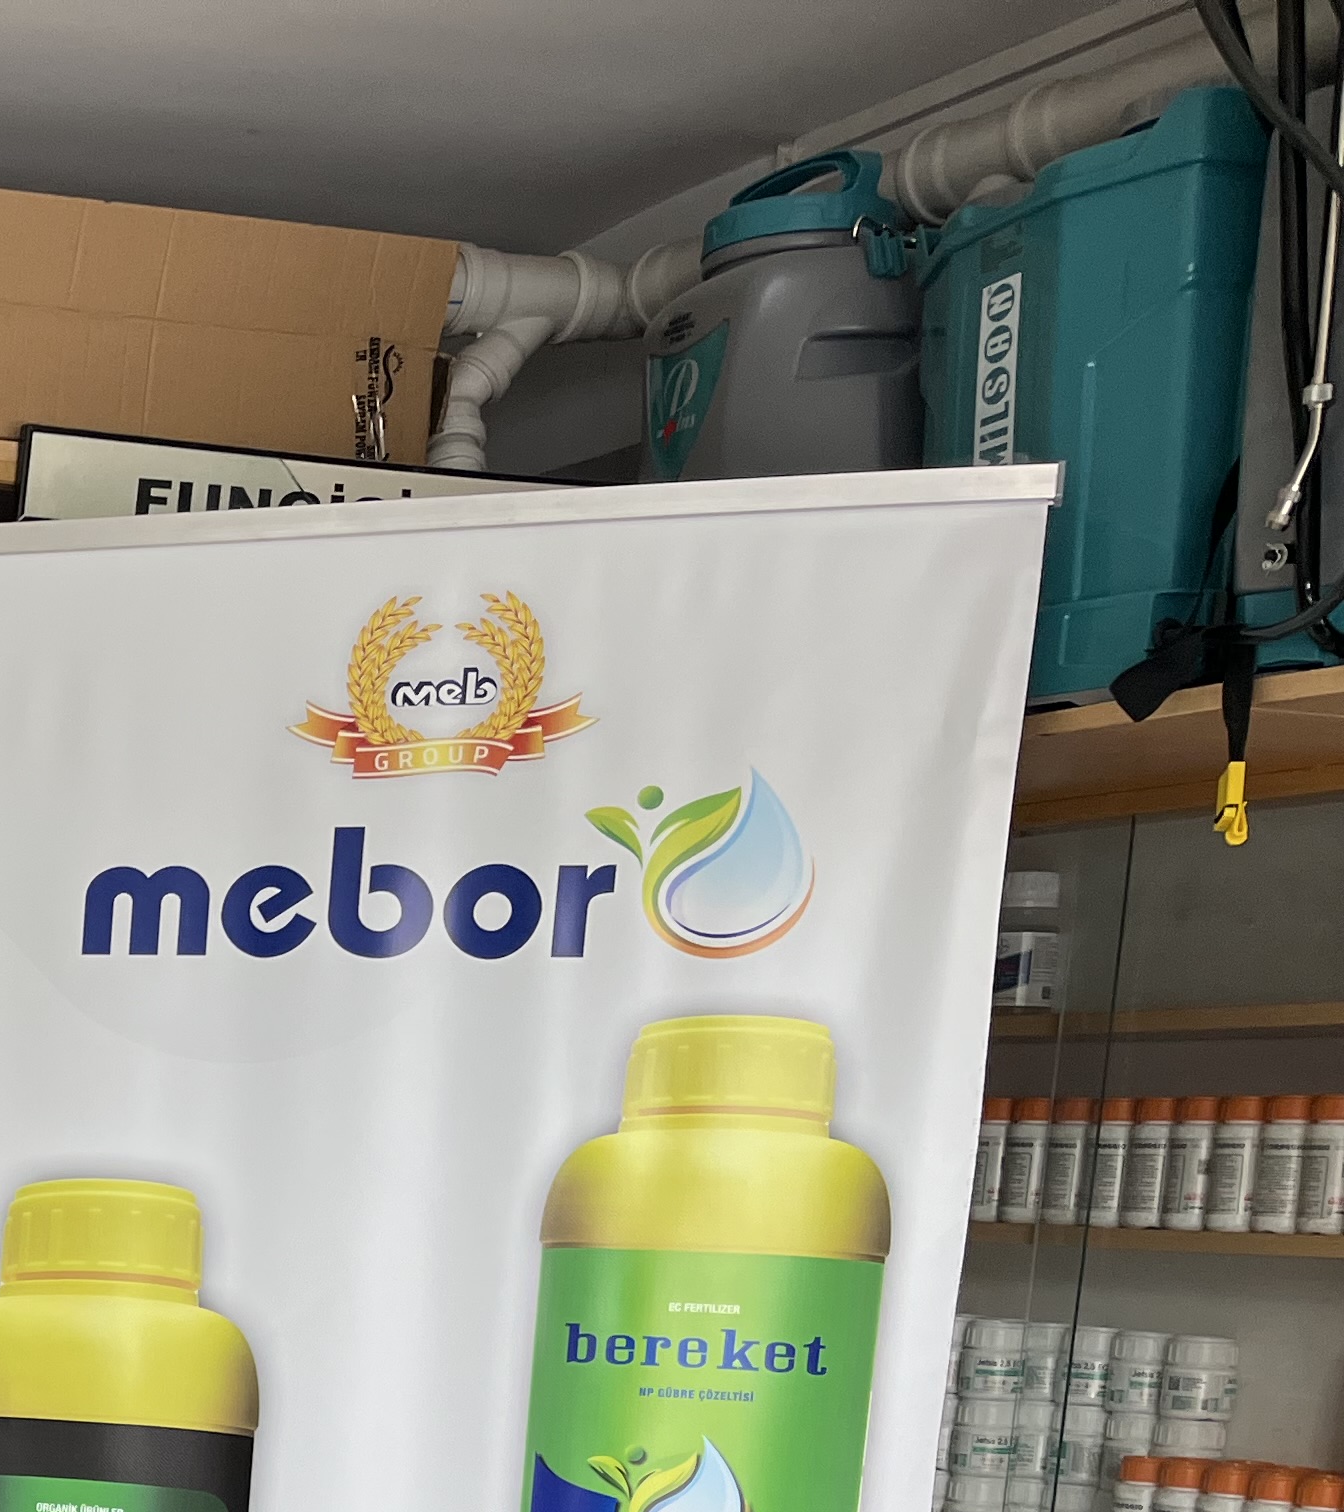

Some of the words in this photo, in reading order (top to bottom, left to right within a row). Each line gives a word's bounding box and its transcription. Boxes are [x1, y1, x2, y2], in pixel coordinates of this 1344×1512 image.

[392, 668, 497, 707] meb
[373, 743, 490, 772] GROUP
[81, 827, 617, 960] mebor
[668, 1302, 682, 1313] EC
[684, 1302, 740, 1316] FERTILIZER
[565, 1322, 827, 1377] bereket
[639, 1386, 655, 1399] NP
[658, 1385, 695, 1400] GÜBRE
[699, 1388, 754, 1405] ÇÖZELTİSİ
